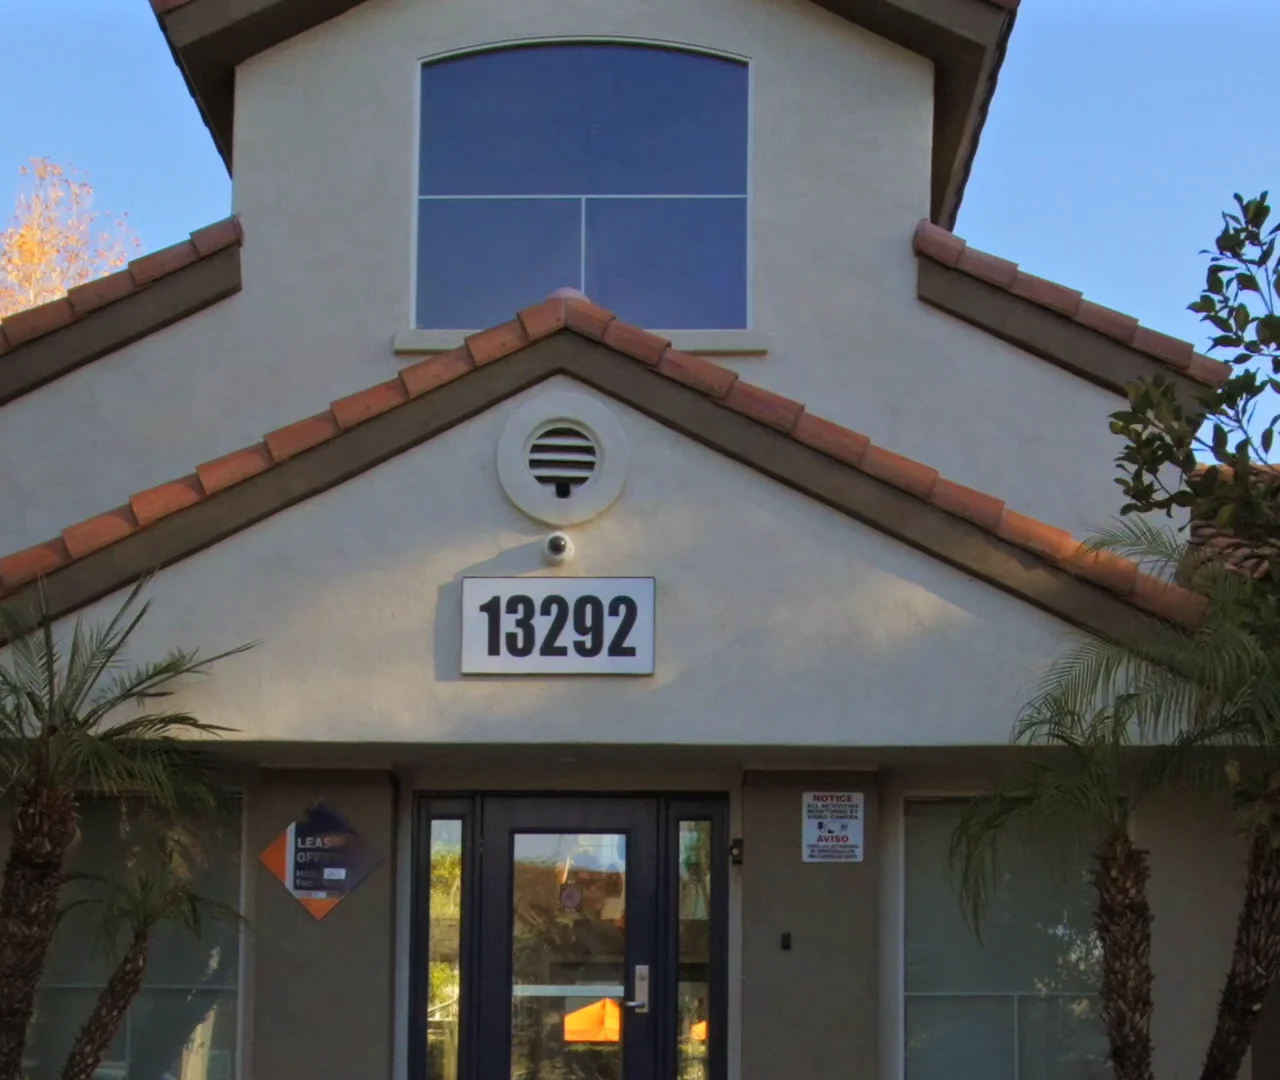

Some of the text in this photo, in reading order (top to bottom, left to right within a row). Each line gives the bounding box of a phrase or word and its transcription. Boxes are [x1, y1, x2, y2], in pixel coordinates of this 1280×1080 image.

[478, 594, 638, 658] 13292
[812, 794, 853, 803] NOTICE
[816, 835, 849, 843] AVISO
